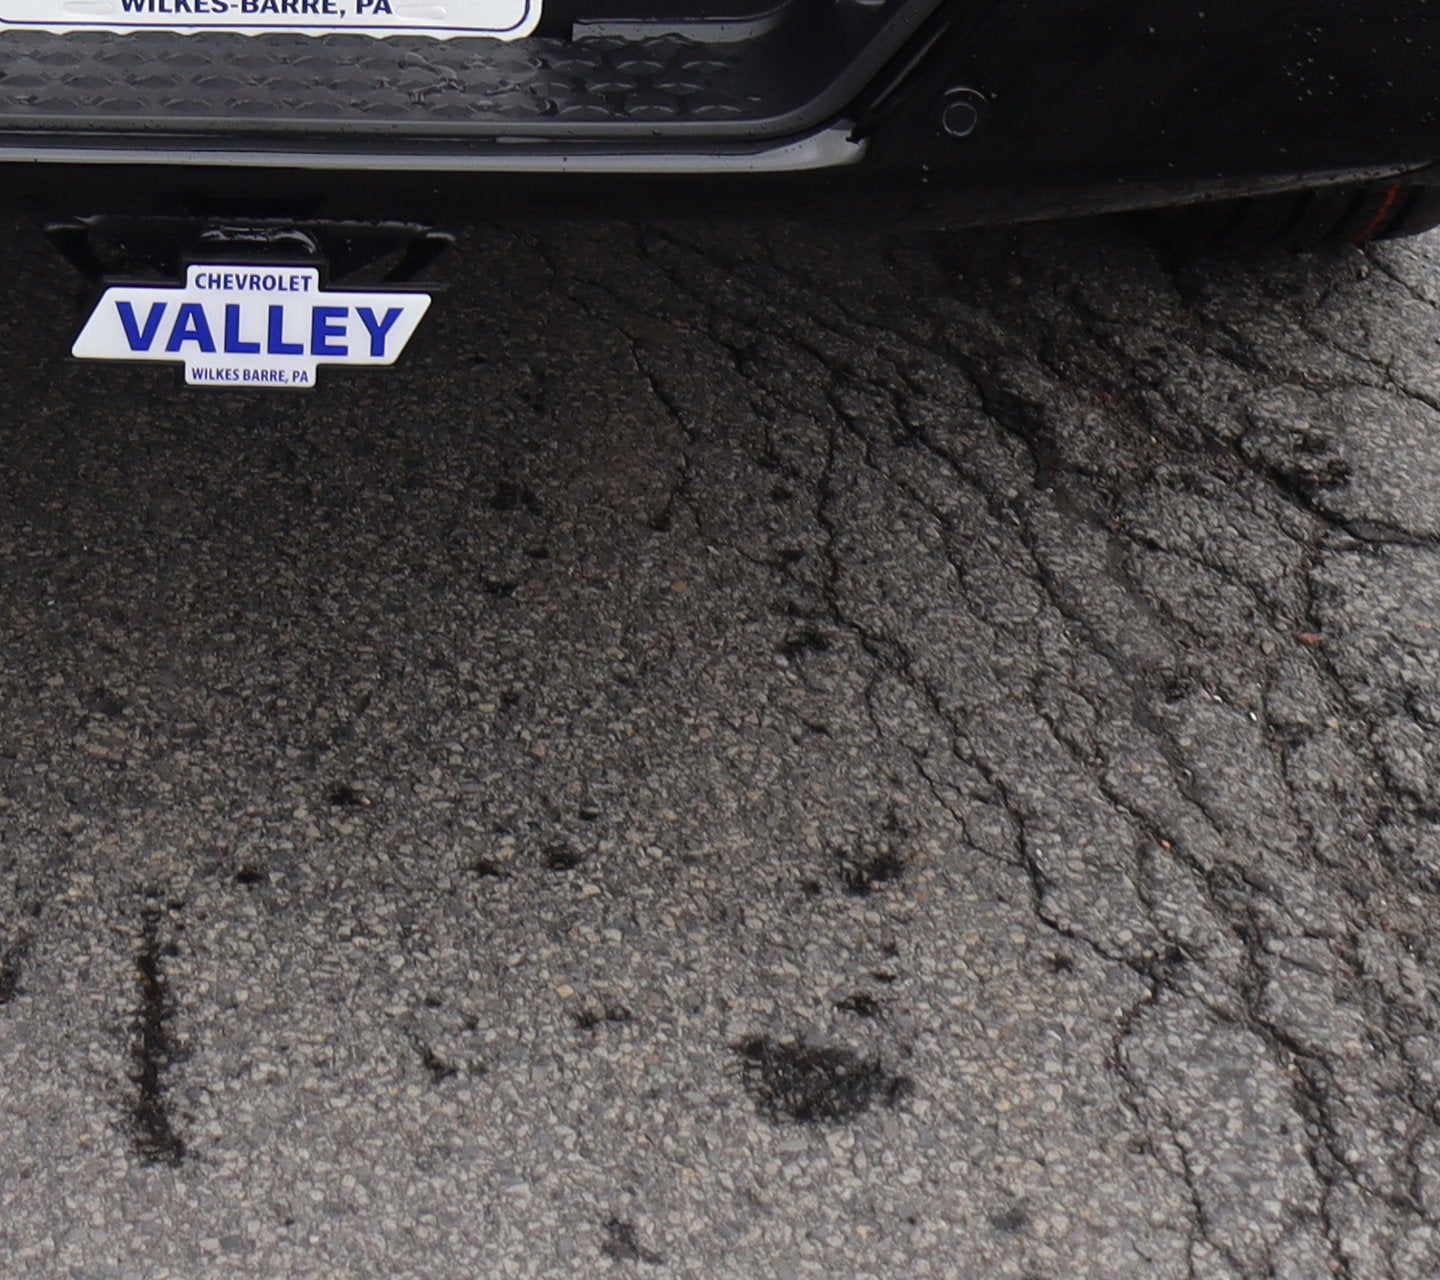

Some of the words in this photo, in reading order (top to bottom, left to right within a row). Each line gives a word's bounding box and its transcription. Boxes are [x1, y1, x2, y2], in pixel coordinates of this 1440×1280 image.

[194, 272, 313, 292] CHEVROLET
[114, 300, 405, 357] VALLEY
[191, 367, 240, 382] WILKES
[243, 368, 289, 384] BARRE,
[292, 370, 309, 383] PA
